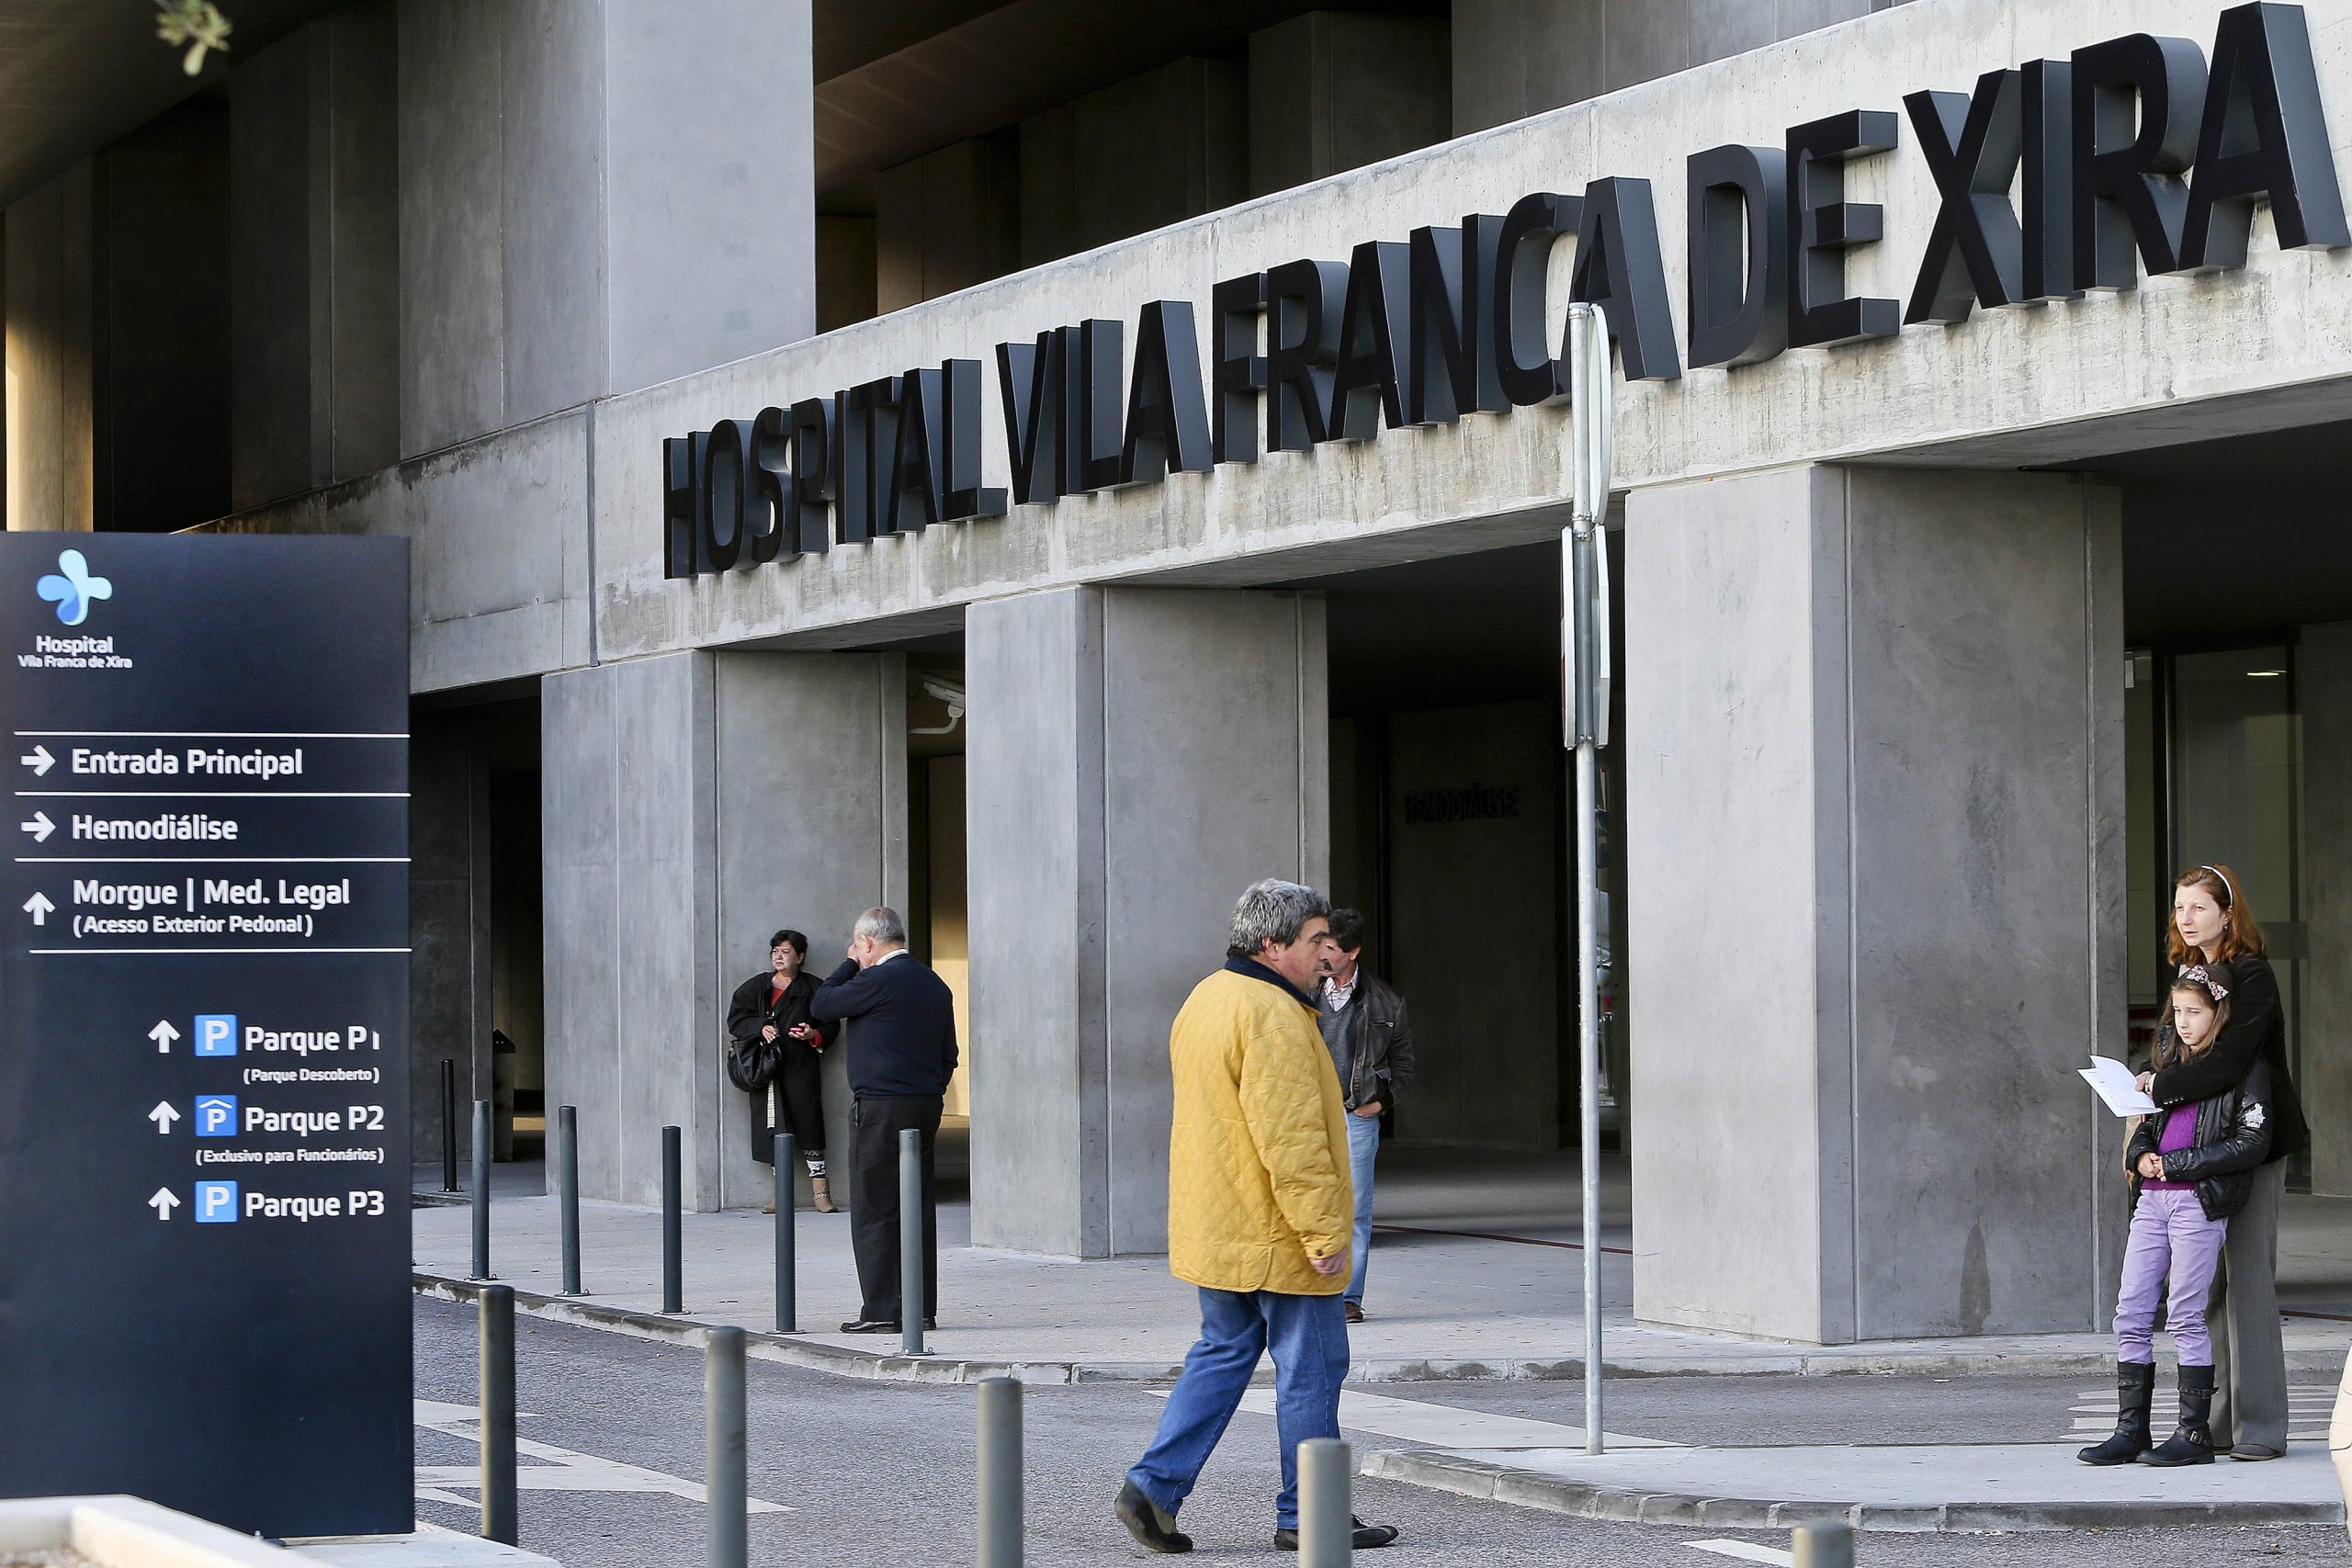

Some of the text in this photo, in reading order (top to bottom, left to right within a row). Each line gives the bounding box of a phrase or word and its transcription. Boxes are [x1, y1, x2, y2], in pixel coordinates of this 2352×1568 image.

[662, 1, 2350, 580] HOSPITAL VILA FRANCA DE XIRA
[36, 636, 113, 656] Hospital
[17, 655, 132, 668] Vila Franca de Xira
[73, 749, 302, 780] Entrada Principal
[73, 814, 238, 840] Hemodiálise
[74, 880, 177, 910] Morgue
[204, 879, 270, 904] Med.
[279, 879, 349, 909] Legal
[74, 915, 312, 938] (Acesso Exterior Pedonal)
[245, 1027, 340, 1056] Parque
[243, 1067, 379, 1085] (Parque Descoberto)
[246, 1107, 340, 1136] Parque
[348, 1106, 384, 1130] P2
[196, 1147, 384, 1166] (Exclusivo para Funcionários)
[246, 1193, 340, 1222] Parque
[349, 1190, 384, 1215] P3
